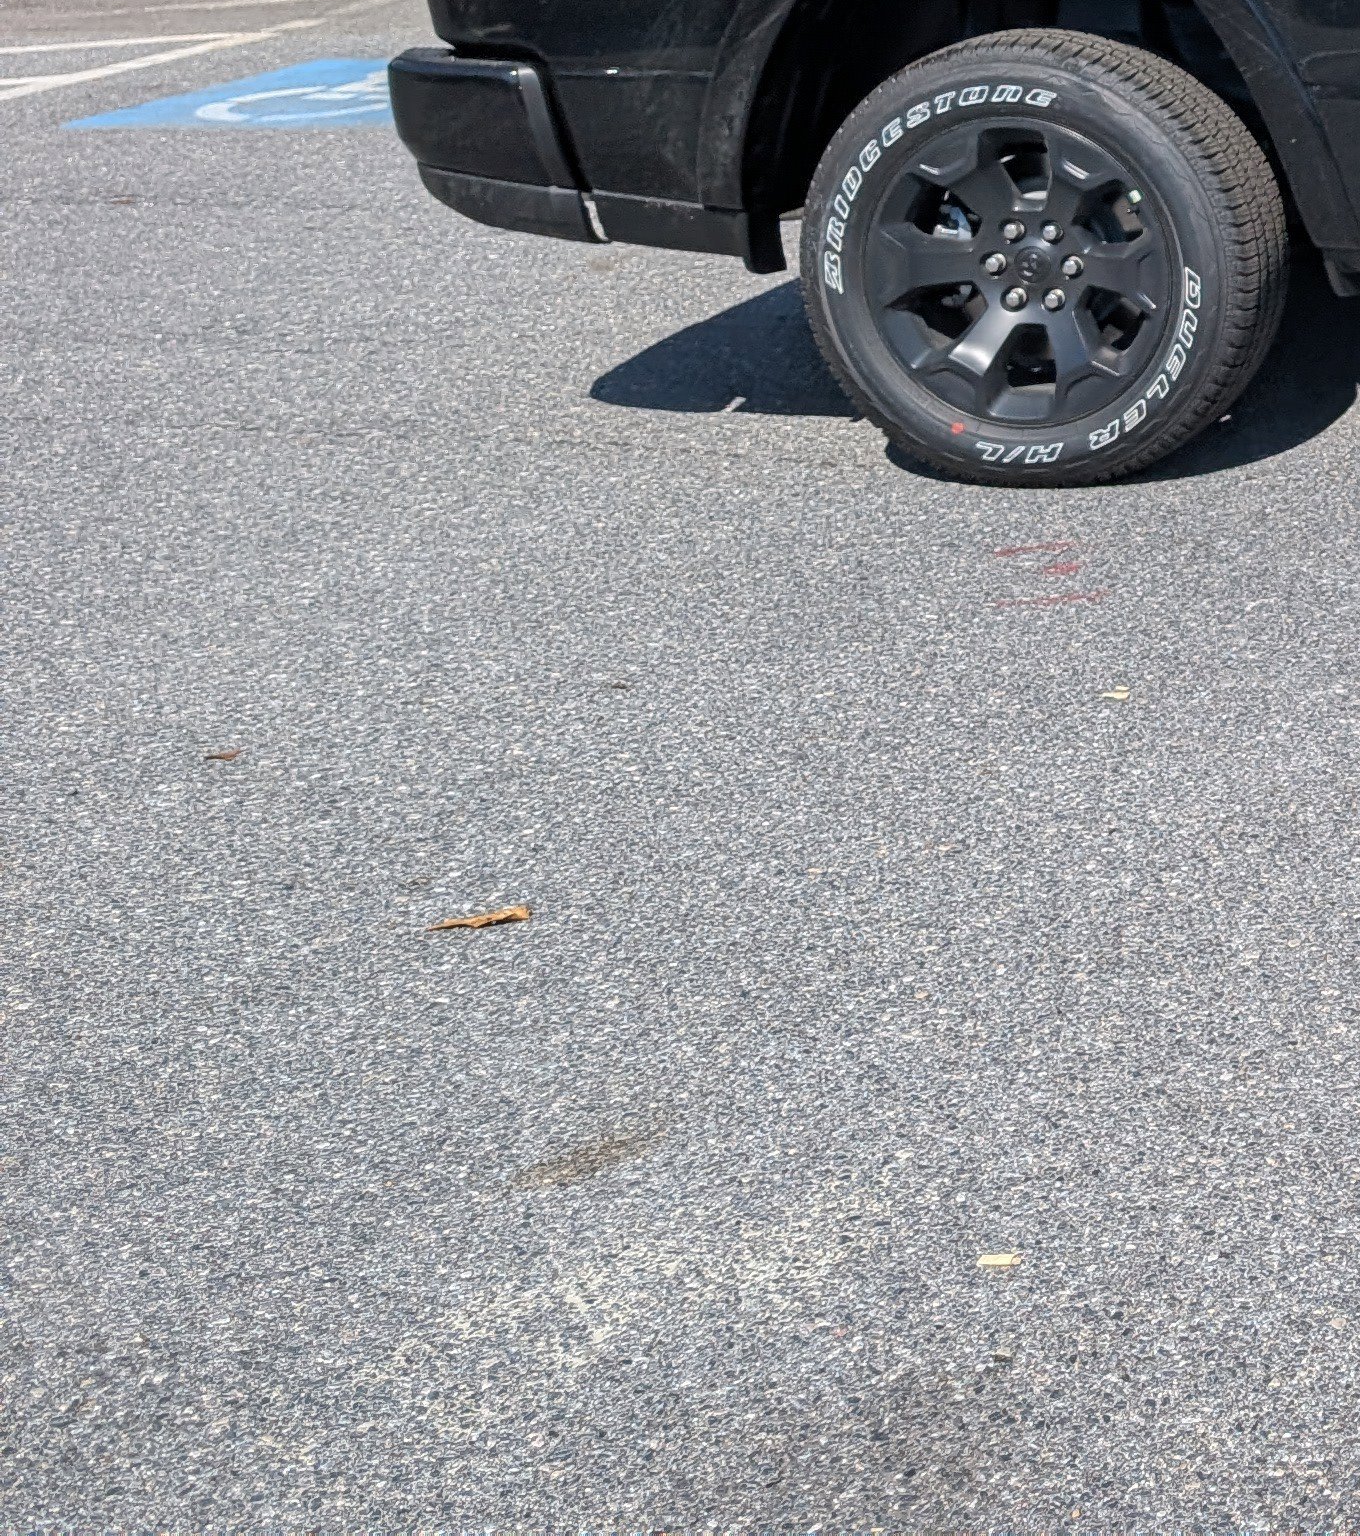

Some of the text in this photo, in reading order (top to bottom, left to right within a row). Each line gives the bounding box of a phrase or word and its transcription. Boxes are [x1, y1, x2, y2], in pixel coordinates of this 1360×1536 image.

[823, 83, 1058, 295] BRIDGESTONE
[974, 265, 1202, 464] DUELER H/L
